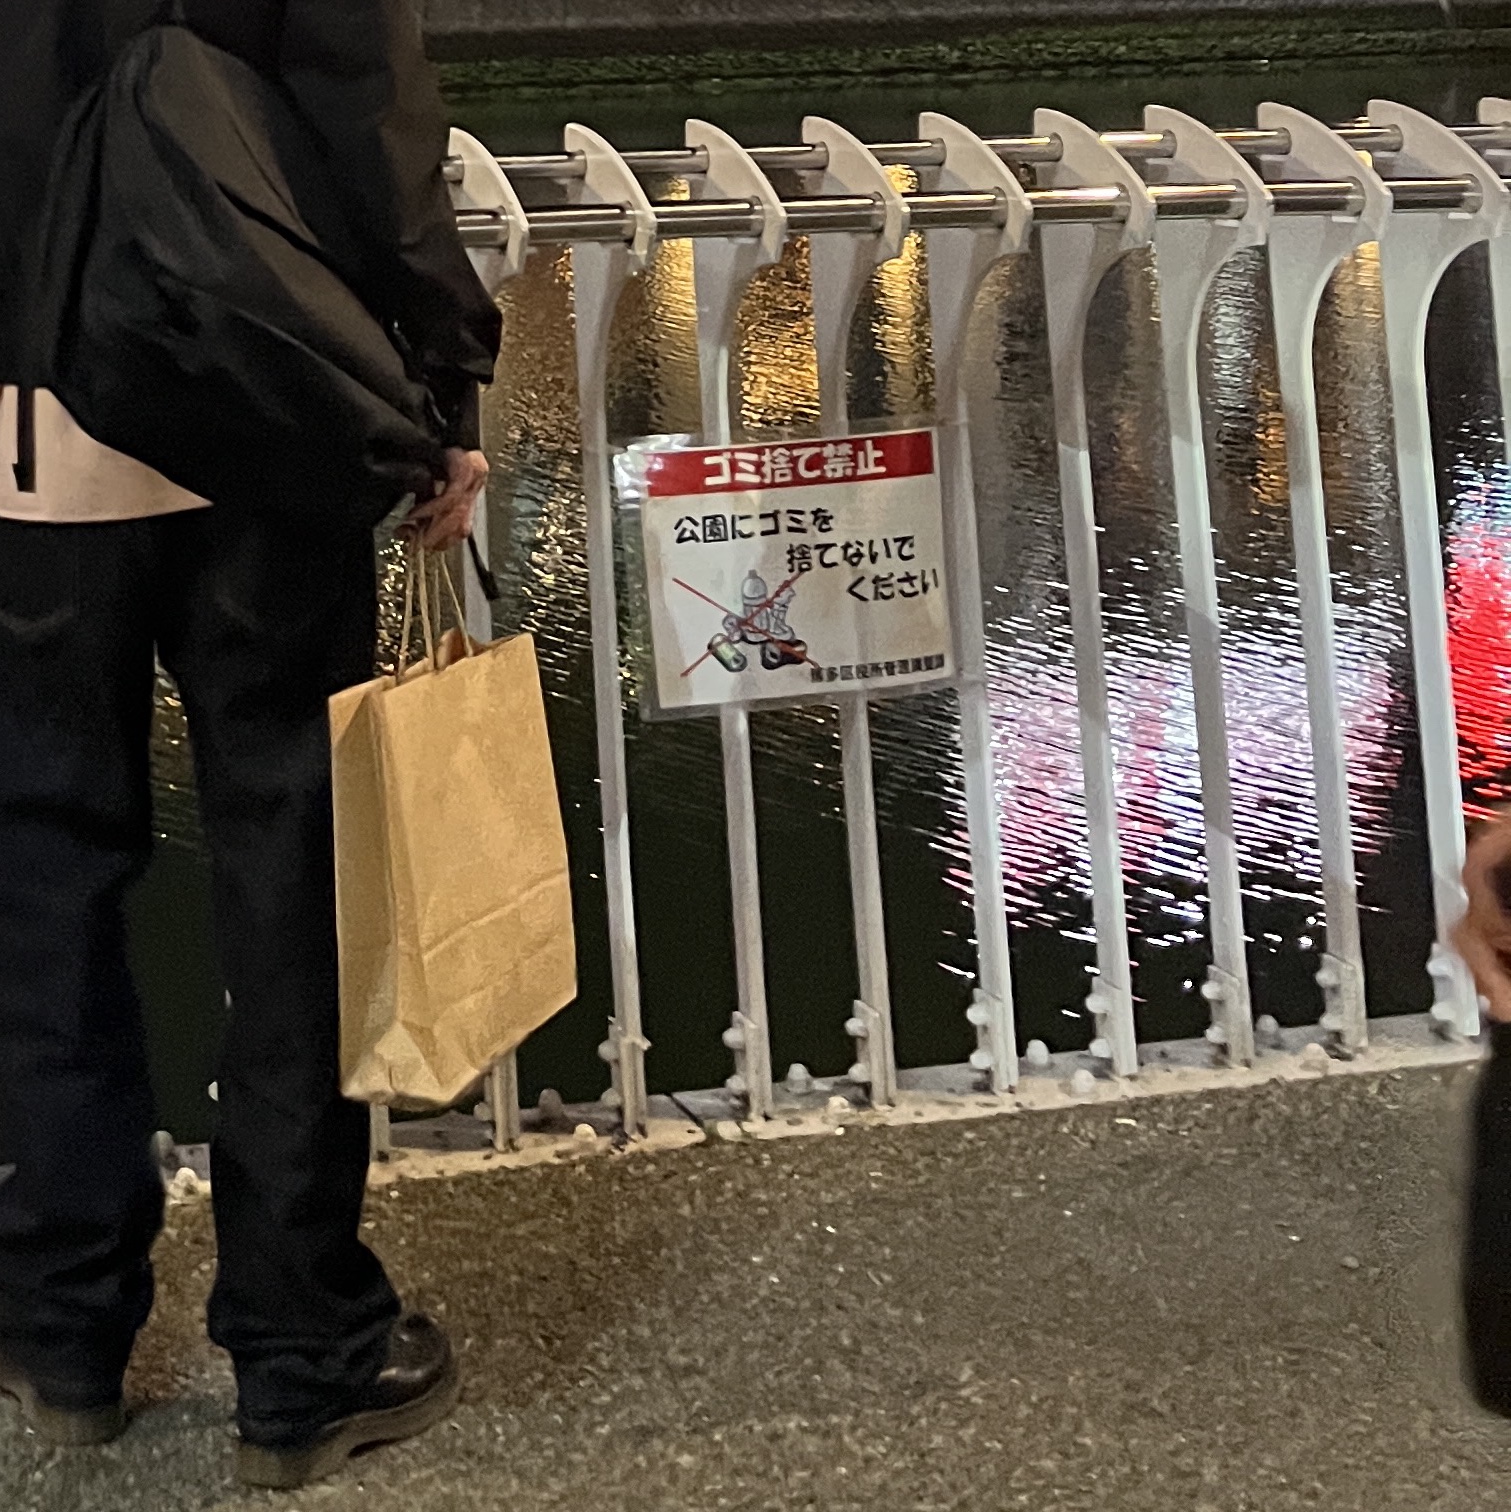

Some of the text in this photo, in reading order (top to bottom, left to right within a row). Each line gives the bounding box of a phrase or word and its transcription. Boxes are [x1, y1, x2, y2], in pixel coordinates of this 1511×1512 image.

[703, 439, 887, 486] ゴミ捨て禁止
[673, 507, 835, 544] 公園にゴミを
[786, 535, 916, 573] 捨てないで
[846, 566, 940, 602] ください
